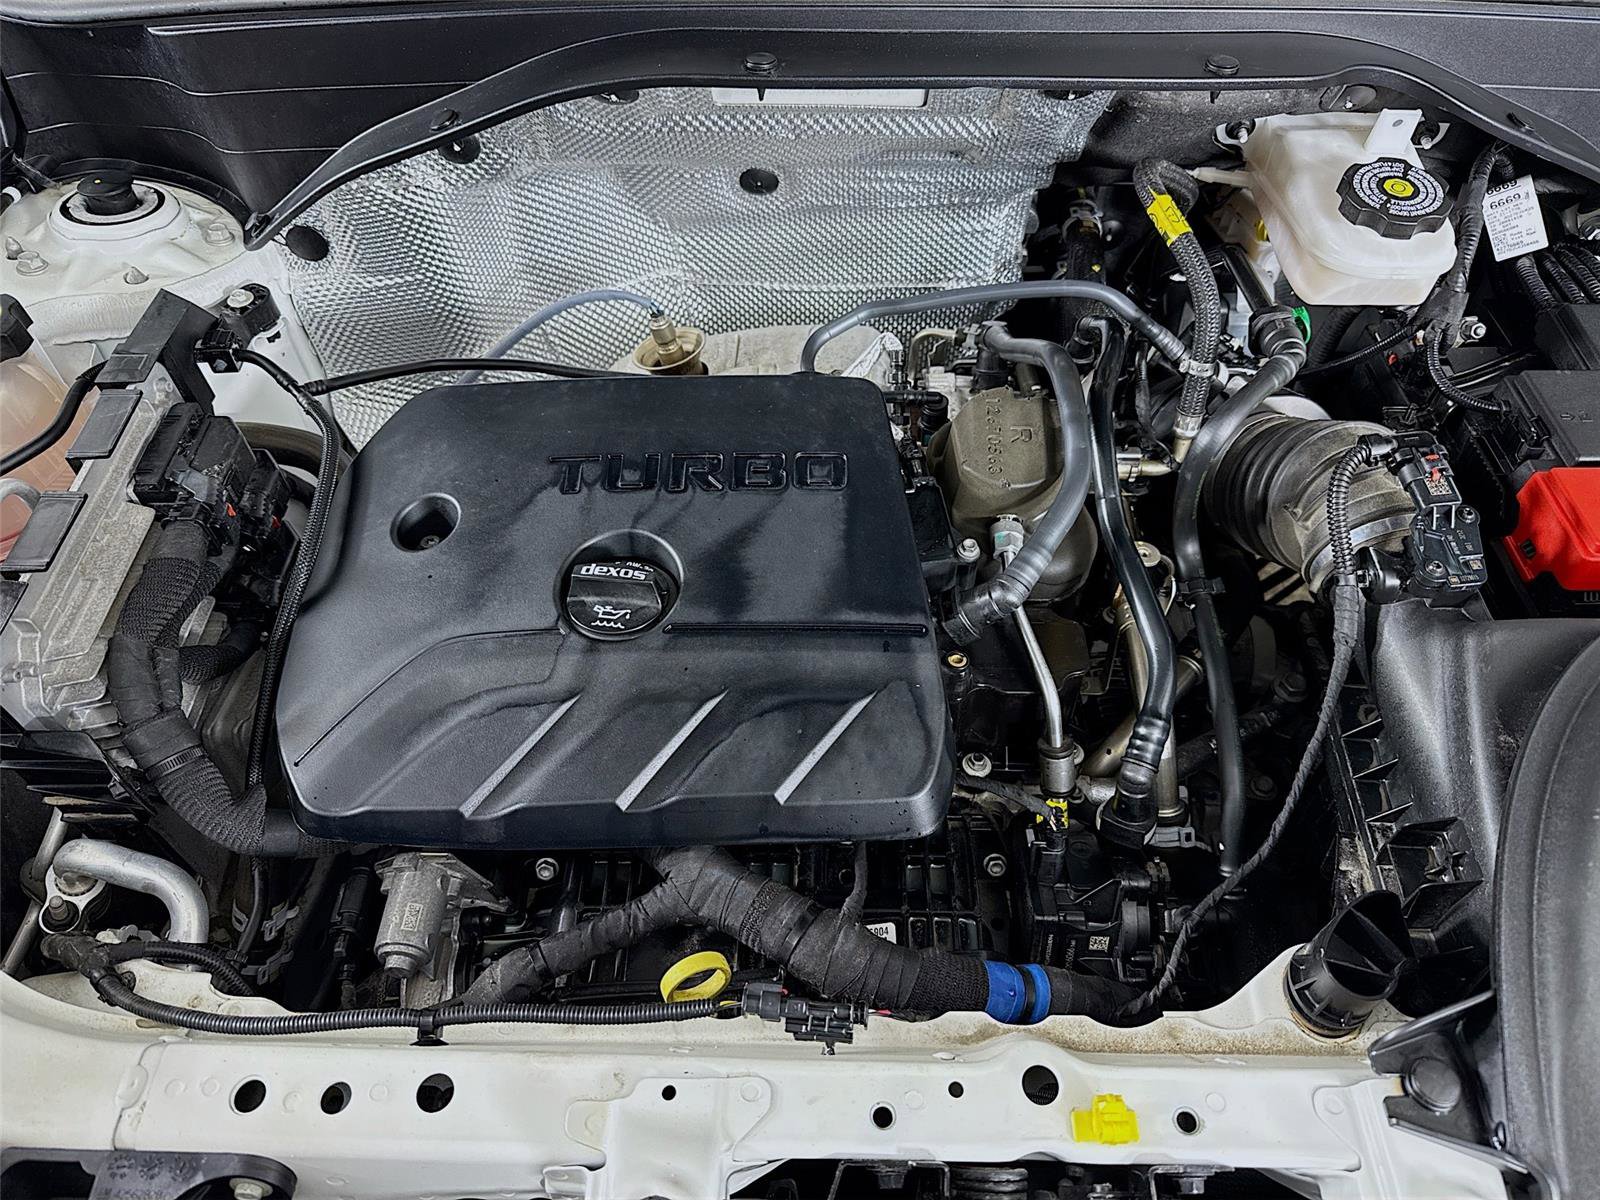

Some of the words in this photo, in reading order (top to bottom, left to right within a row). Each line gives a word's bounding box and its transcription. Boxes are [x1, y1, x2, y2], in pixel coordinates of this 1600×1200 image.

[1490, 193, 1522, 210] 6669
[1010, 426, 1032, 443] R
[548, 452, 848, 494] TURBO
[580, 564, 646, 580] dexos
[870, 926, 888, 936] 904
